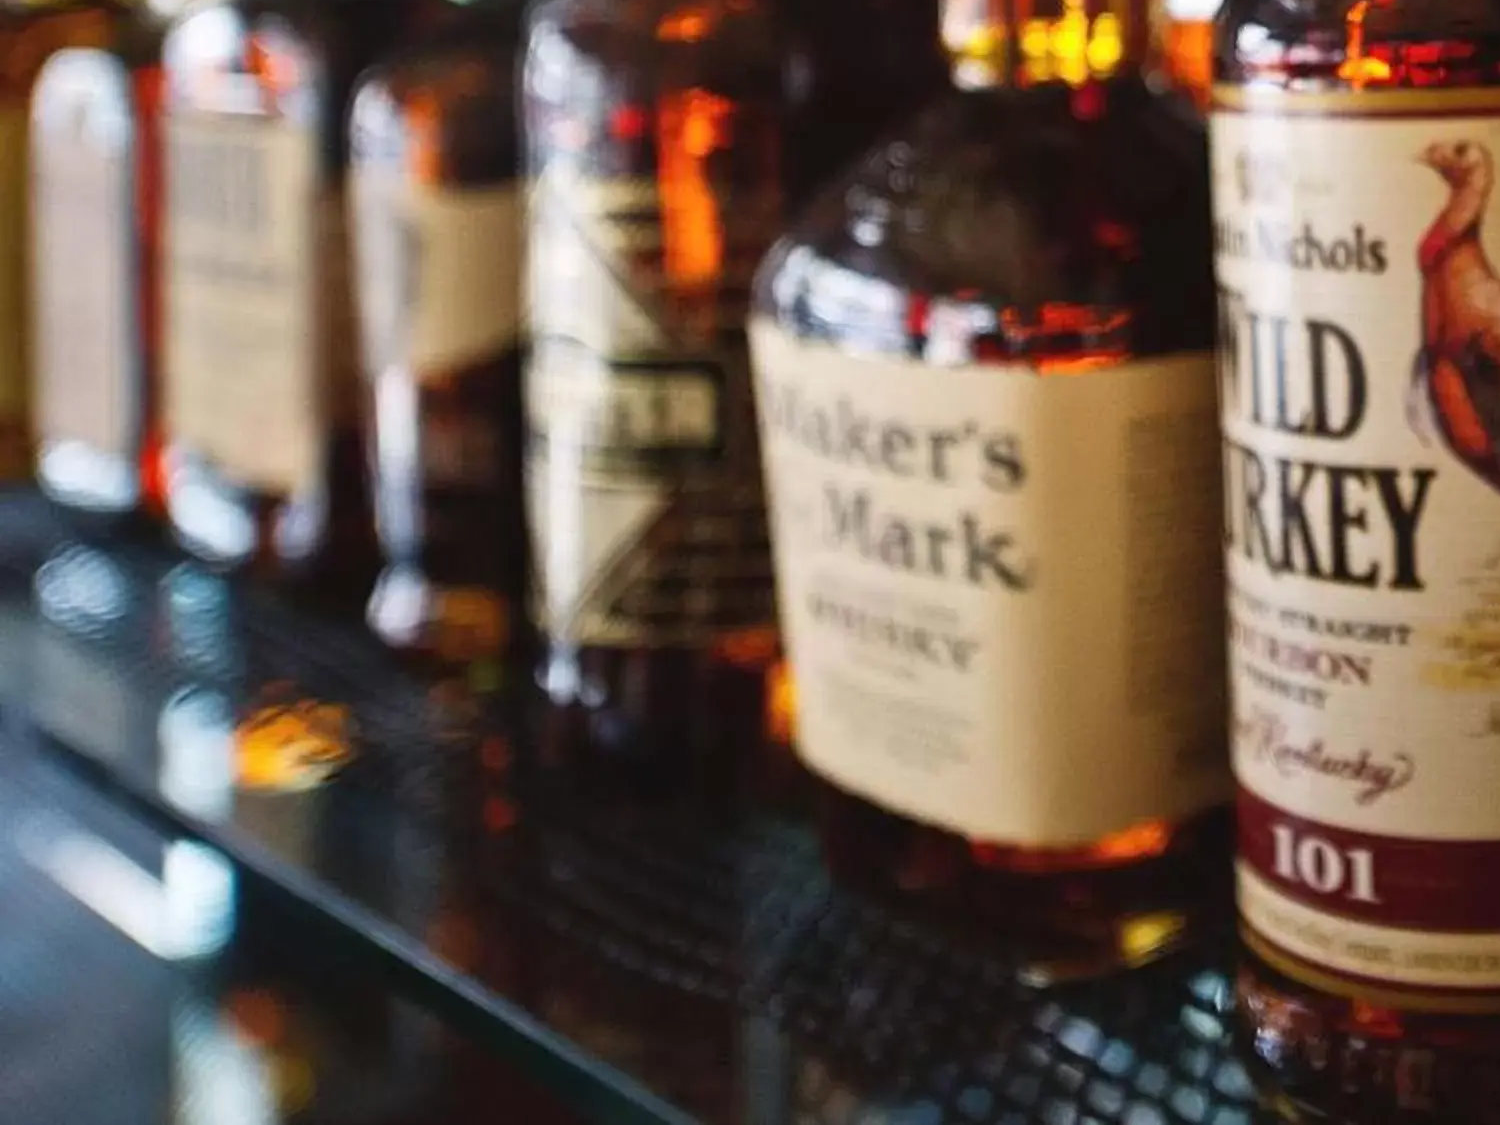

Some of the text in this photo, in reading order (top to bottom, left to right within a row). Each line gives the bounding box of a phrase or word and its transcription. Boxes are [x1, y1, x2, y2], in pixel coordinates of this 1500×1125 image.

[823, 482, 1033, 595] Mark
[1225, 437, 1437, 592] RKEY
[1272, 824, 1381, 905] 101
